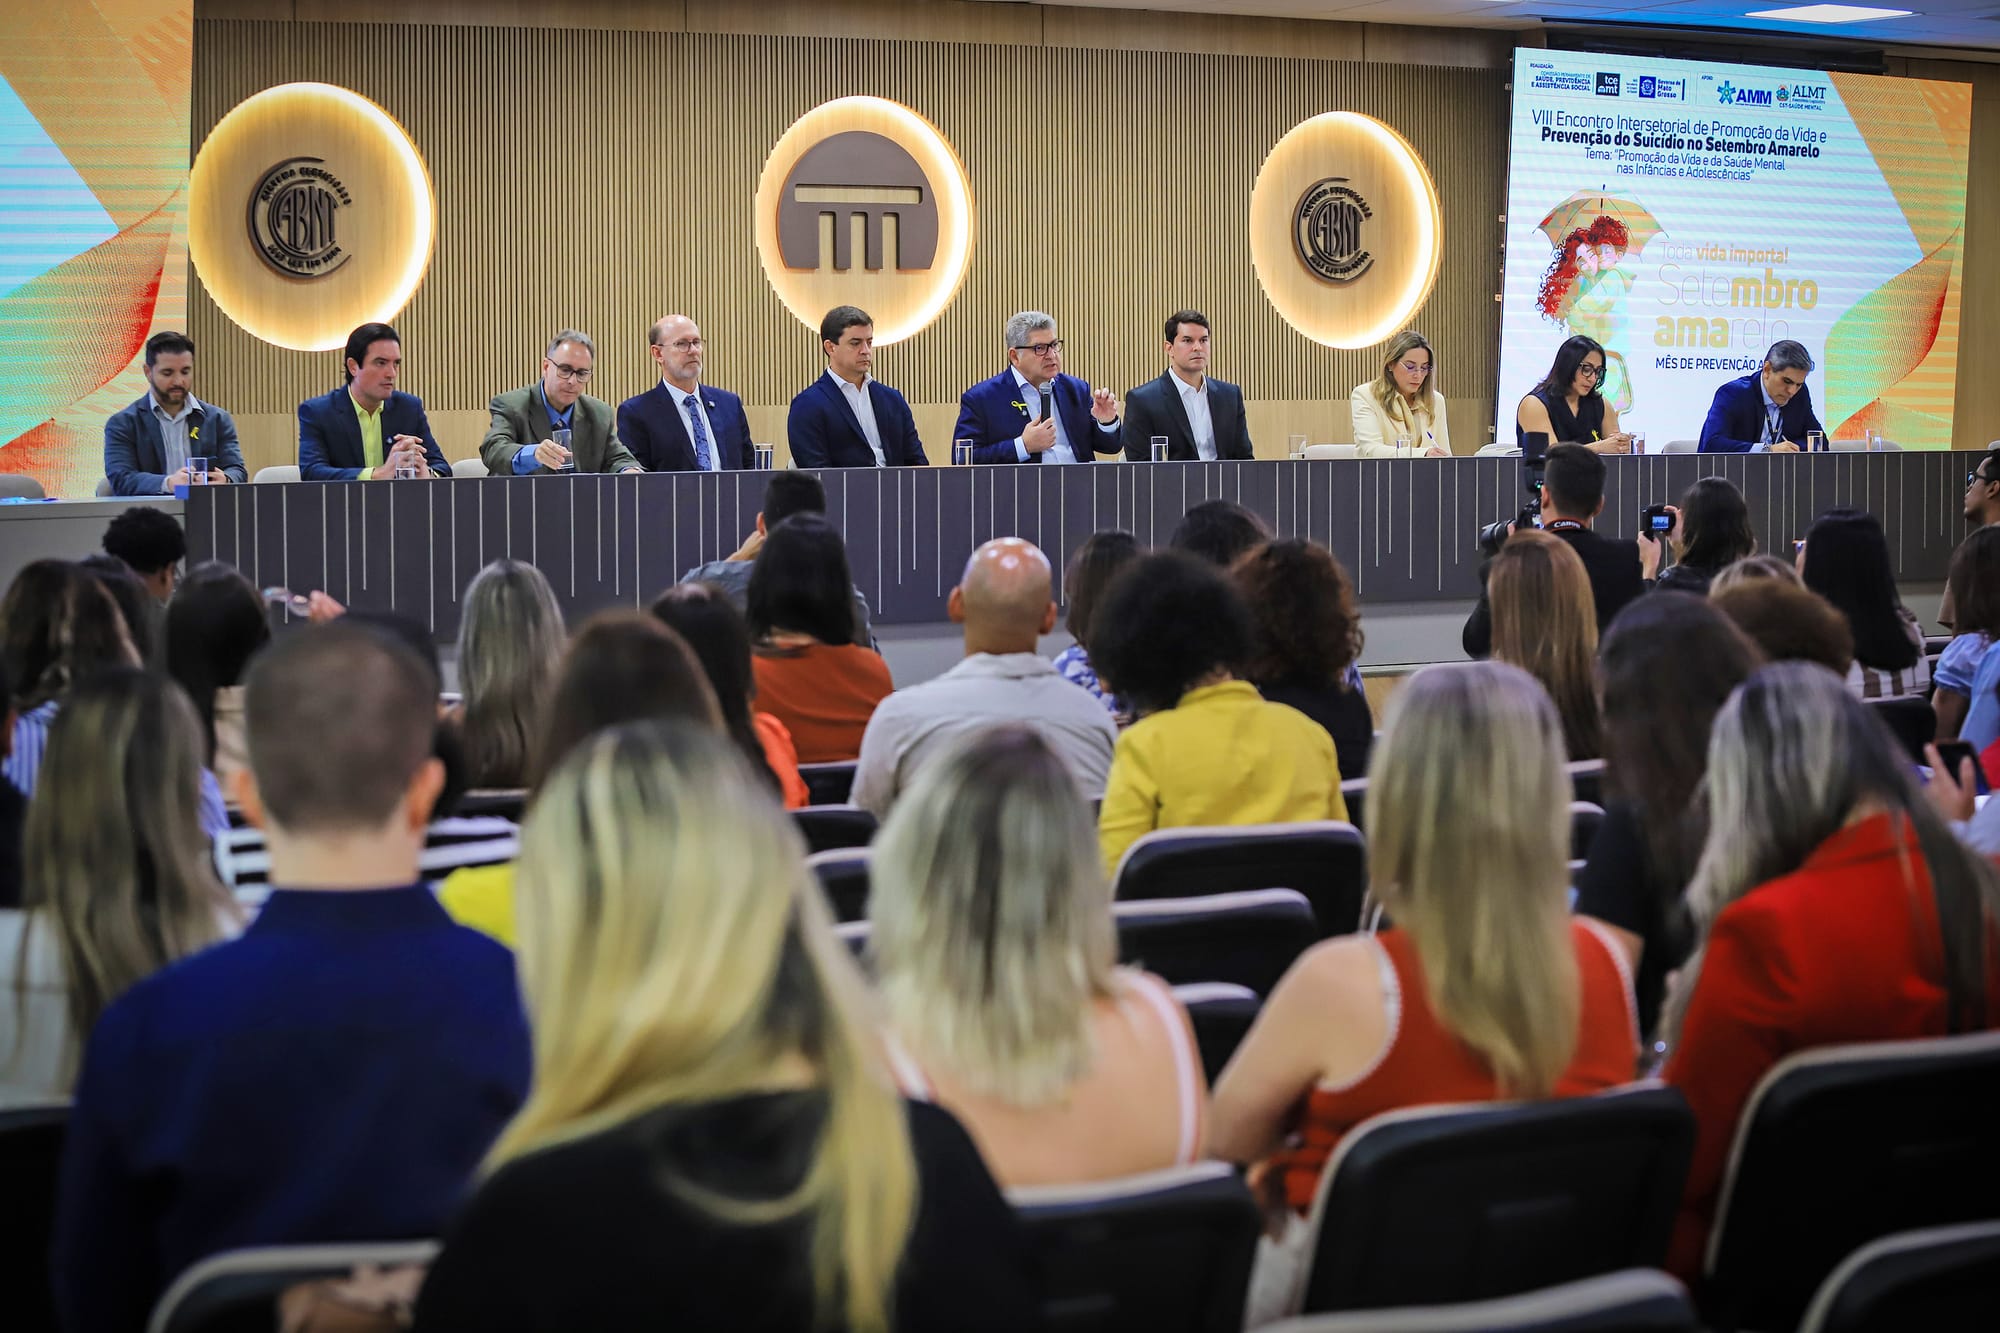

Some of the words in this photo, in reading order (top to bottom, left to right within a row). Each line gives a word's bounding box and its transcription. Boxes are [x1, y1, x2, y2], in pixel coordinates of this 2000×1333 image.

[1605, 75, 1618, 85] tce
[1792, 85, 1827, 99] ALMT
[1736, 88, 1772, 105] AMM
[1532, 109, 1553, 126] VIII
[1556, 111, 1613, 130] Encontro
[1617, 114, 1691, 134] Intersetorial
[1694, 119, 1709, 135] de
[1712, 121, 1772, 140] Promoção
[1775, 125, 1789, 141] da
[1792, 126, 1817, 143] Vida
[1819, 132, 1827, 143] e
[1541, 126, 1612, 146] Prevenção
[1614, 131, 1631, 146] do
[1633, 132, 1685, 149] Suicídio
[1687, 138, 1703, 151] no
[1705, 136, 1766, 155] Setembro
[1767, 141, 1820, 158] Amarelo
[1584, 147, 1612, 160] Tema:
[1668, 152, 1679, 164] da
[1681, 153, 1701, 165] Vida
[1703, 157, 1709, 166] e
[1711, 154, 1722, 167] da
[1723, 155, 1751, 168] Saúde
[1754, 158, 1786, 171] Mental
[1616, 164, 1634, 175] nas
[1636, 163, 1677, 177] Infâncias
[1679, 168, 1684, 177] e
[1660, 241, 1692, 260] Toda
[1696, 242, 1727, 261] vida
[1729, 243, 1789, 266] importa!
[1657, 263, 1818, 310] Setembro
[1654, 308, 1789, 348] amarelo
[1655, 354, 1678, 369] MÊS
[1680, 357, 1693, 369] DE
[1696, 355, 1756, 371] PREVENÇÃO
